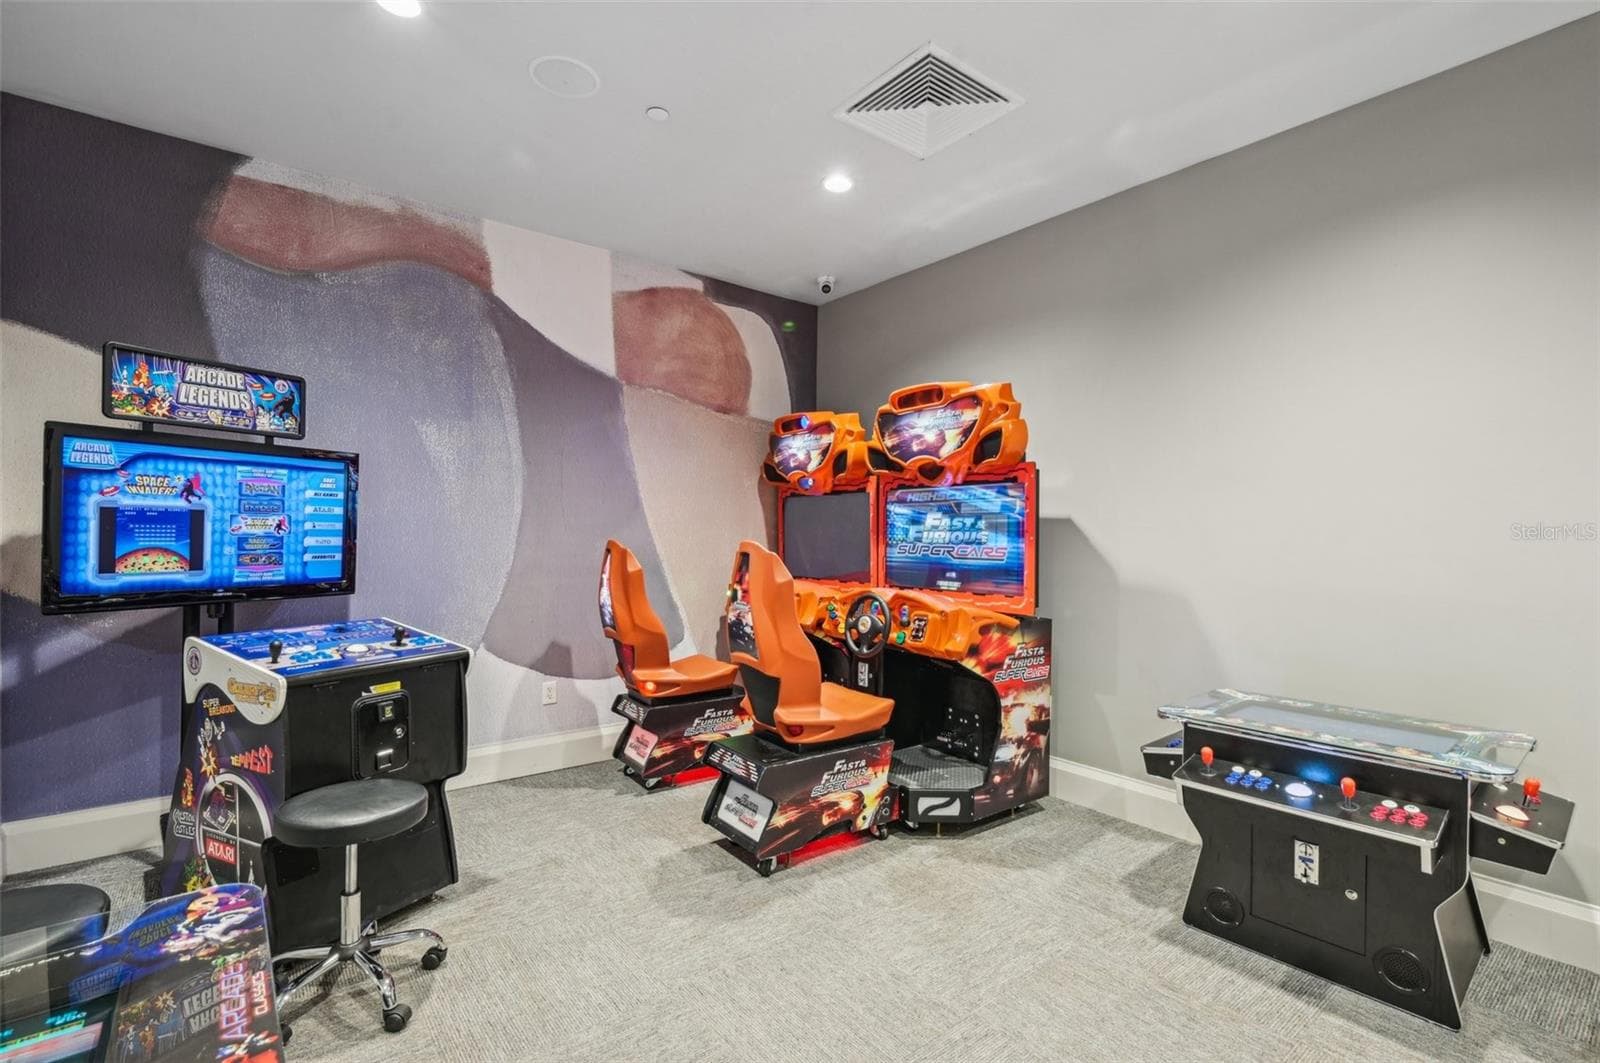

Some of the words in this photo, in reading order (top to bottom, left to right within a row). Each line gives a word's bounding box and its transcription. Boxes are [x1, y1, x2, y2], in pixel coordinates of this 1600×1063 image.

[185, 365, 245, 389] ARCADE
[179, 382, 250, 410] LEGENDS
[74, 442, 111, 453] ARCADE
[70, 451, 115, 465] LEGENDS
[135, 475, 171, 486] SPACE
[125, 485, 178, 496] INVADERS
[924, 512, 975, 531] FAST
[908, 525, 989, 545] FURIOUS
[897, 544, 1008, 562] SUPERCARS
[1003, 654, 1046, 670] FURIOUS
[704, 708, 728, 719] FAST
[834, 759, 860, 772] FAST
[821, 766, 868, 785] FURIOUS
[207, 842, 236, 862] ATARI
